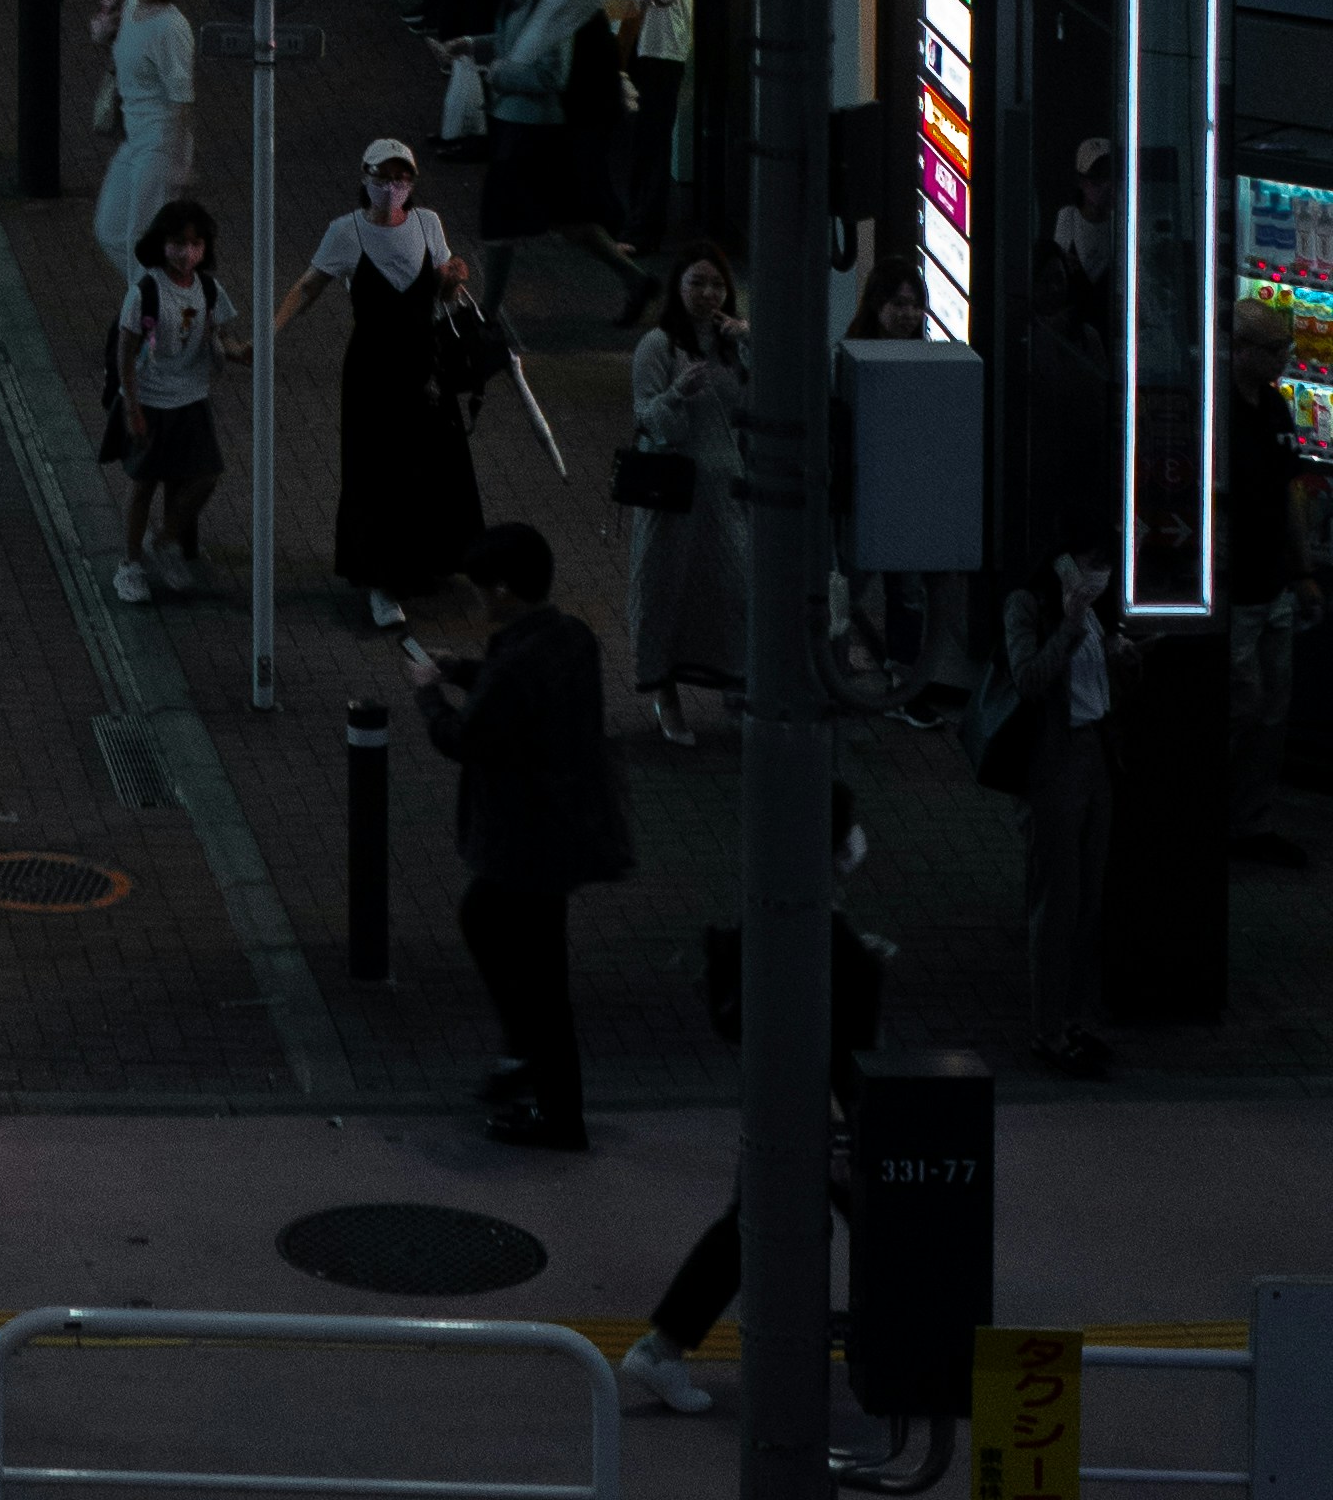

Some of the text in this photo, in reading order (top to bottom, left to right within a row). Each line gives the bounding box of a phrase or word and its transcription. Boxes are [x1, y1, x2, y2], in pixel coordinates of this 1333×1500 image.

[881, 1158, 979, 1184] 331-77
[1014, 1338, 1065, 1500] タクシー
